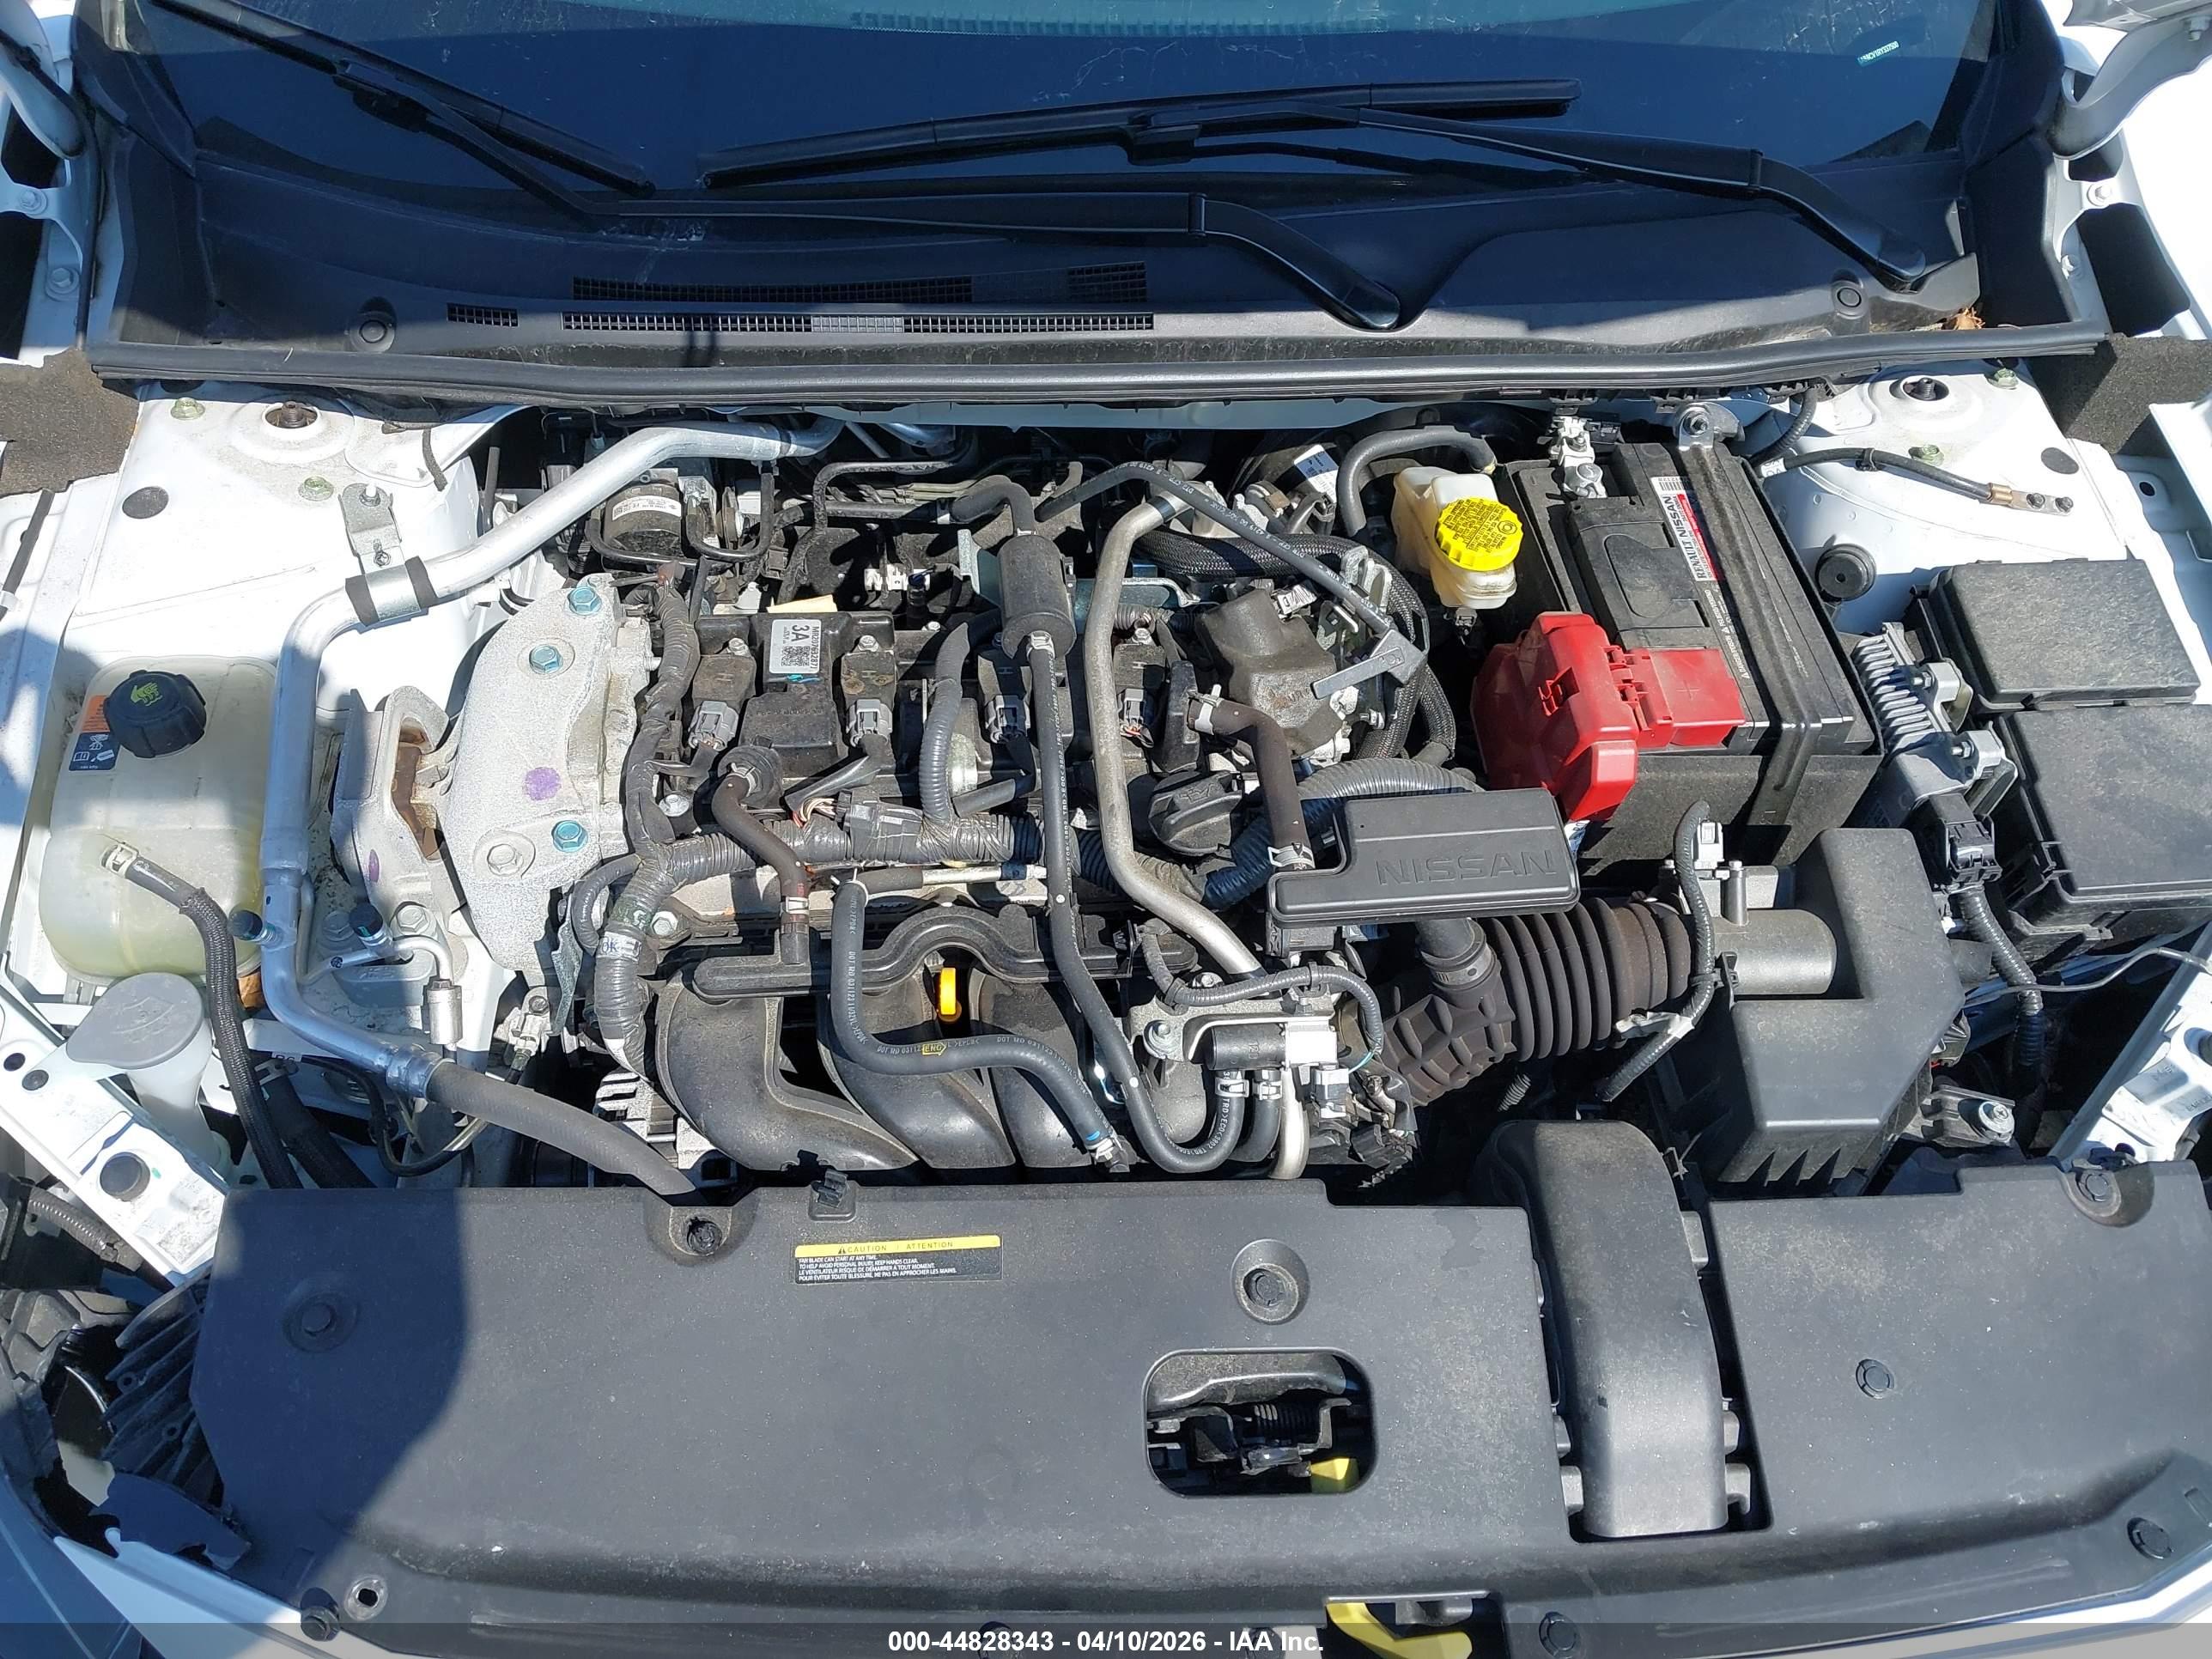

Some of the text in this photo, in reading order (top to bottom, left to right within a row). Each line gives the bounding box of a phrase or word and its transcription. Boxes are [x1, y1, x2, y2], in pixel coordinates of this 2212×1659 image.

[1662, 496, 1687, 538] NISSAN
[1682, 541, 1708, 579] RENAULT
[791, 624, 810, 641] 3A
[1376, 849, 1557, 886] NISSAN
[924, 1044, 943, 1053] ENG
[847, 1245, 887, 1254] CAUTION
[906, 1242, 953, 1250] ATTENTION
